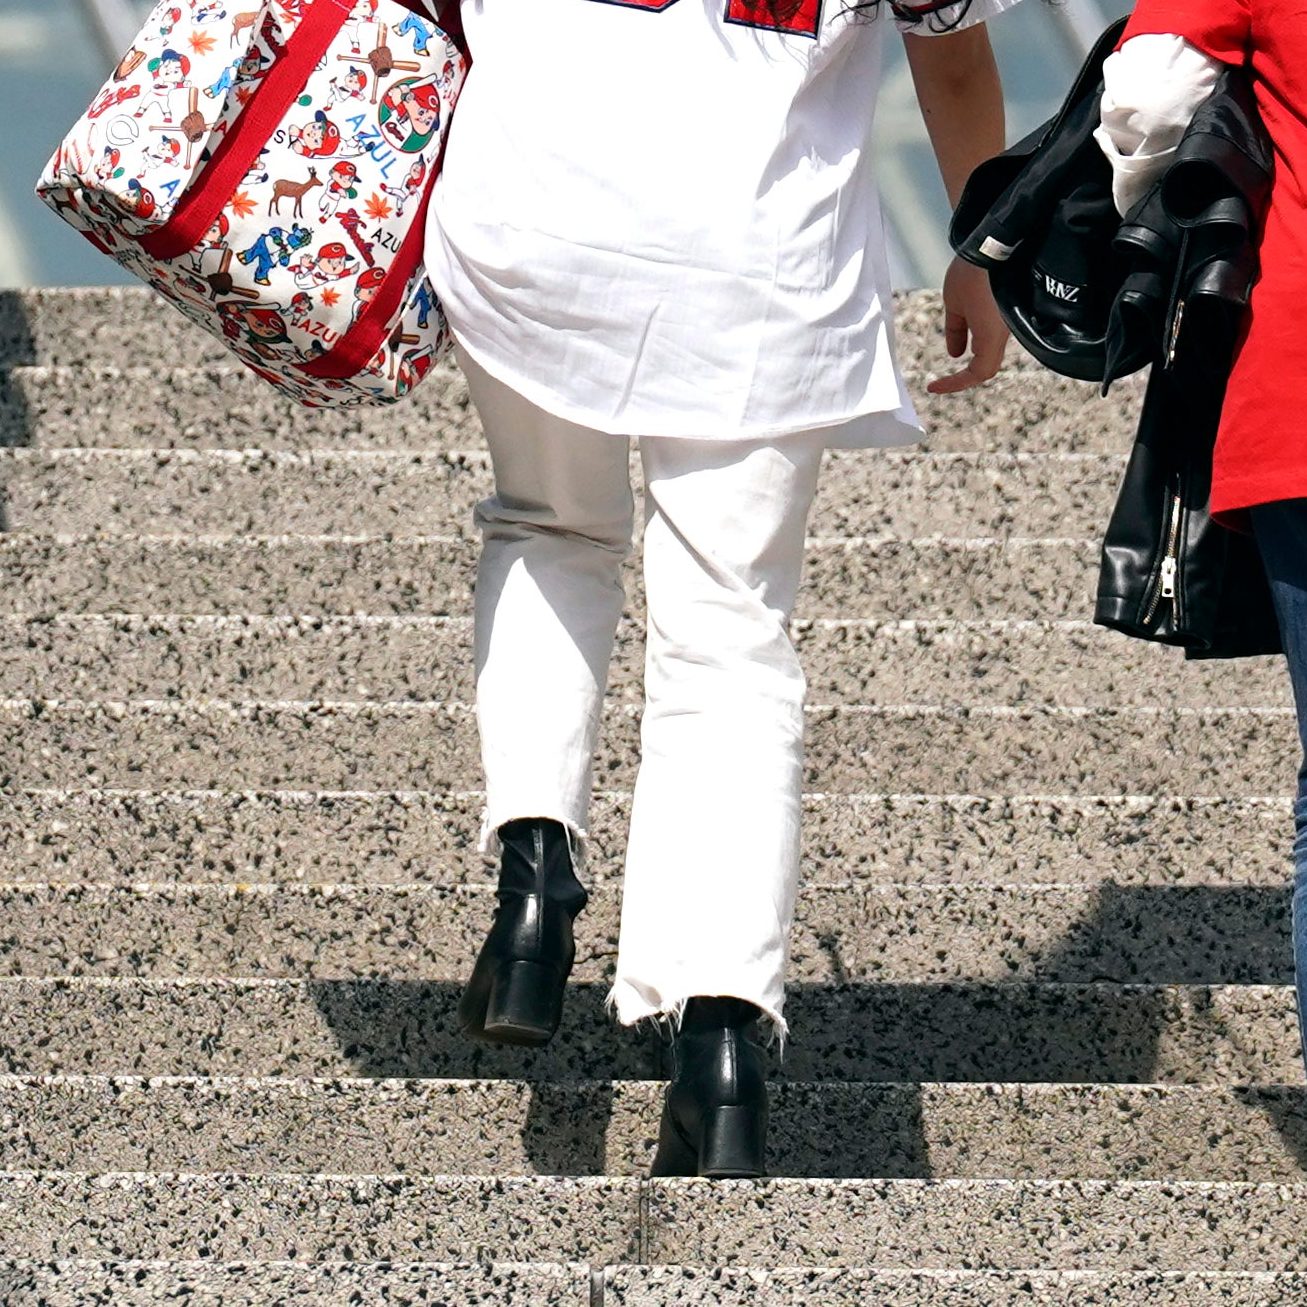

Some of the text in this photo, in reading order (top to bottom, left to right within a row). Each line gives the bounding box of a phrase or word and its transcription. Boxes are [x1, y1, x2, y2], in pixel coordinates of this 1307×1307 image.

[345, 113, 398, 180] AZUL
[371, 227, 402, 254] AZU
[297, 318, 344, 343] AZU
